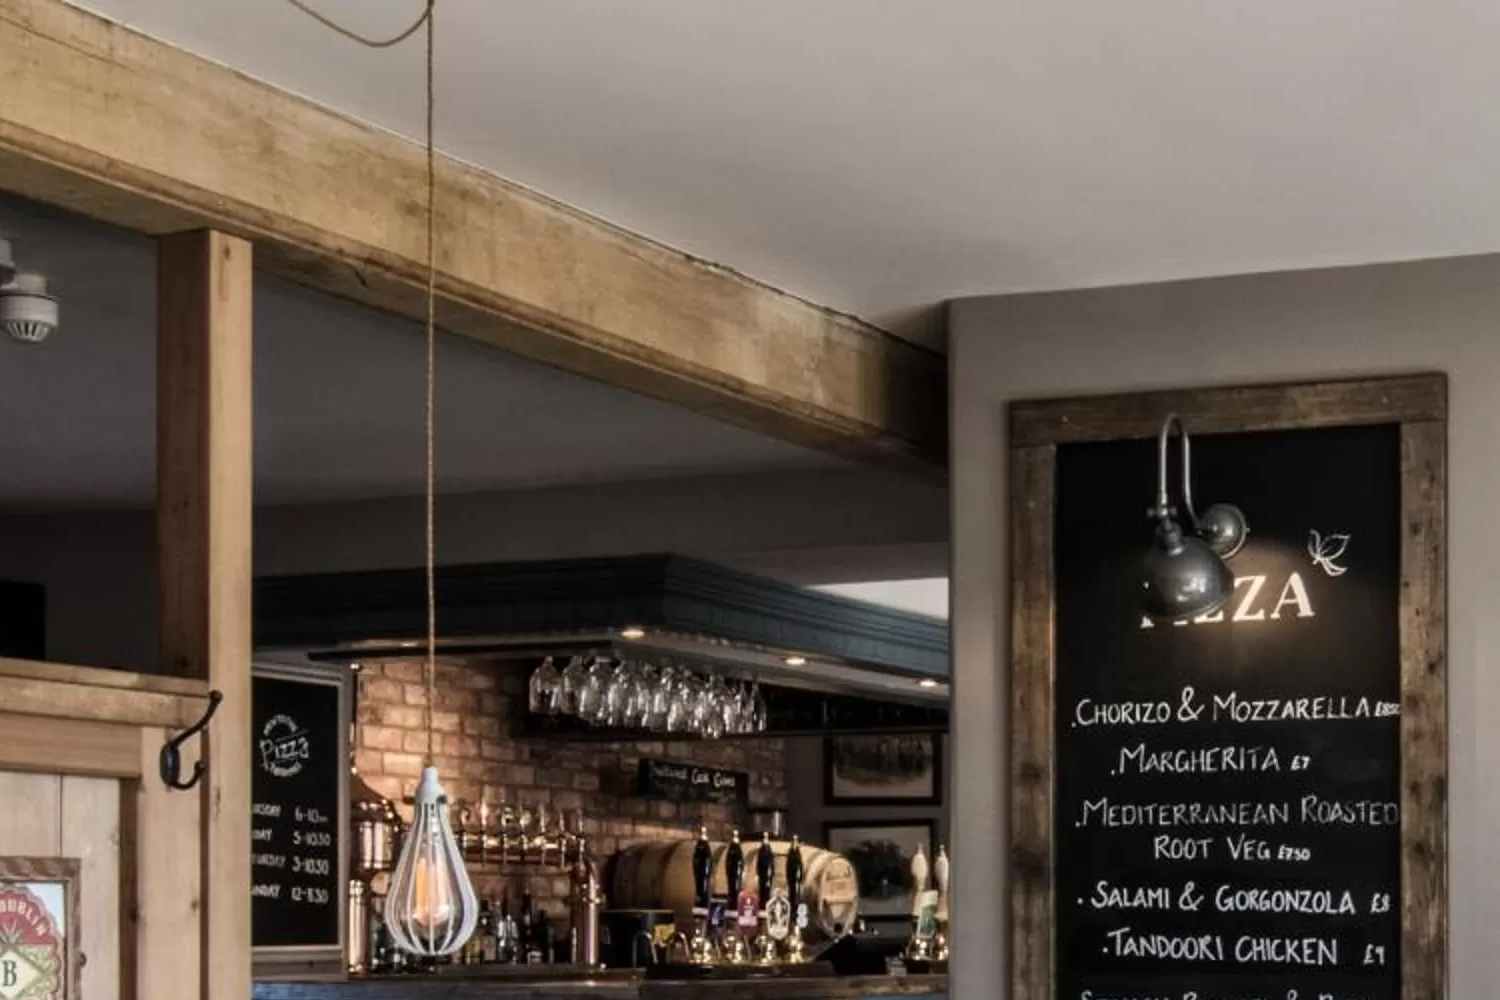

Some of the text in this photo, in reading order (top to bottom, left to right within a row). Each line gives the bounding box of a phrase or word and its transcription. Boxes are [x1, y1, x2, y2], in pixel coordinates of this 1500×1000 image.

[1075, 698, 1171, 725] CHORIZO
[1176, 685, 1205, 723] &
[1213, 691, 1370, 723] MOZZARELLA
[1119, 742, 1281, 774] MARGHERITA
[1082, 794, 1397, 827] MEDITERRANEAN ROASTED
[1153, 834, 1213, 860] ROOT
[1226, 832, 1272, 861] VEG
[1090, 879, 1170, 910] SALAMI
[1178, 881, 1205, 912] &
[1215, 884, 1356, 915] GORGONZOLA
[1107, 926, 1224, 961] TANDOORI
[1234, 935, 1338, 966] CHICKEN
[1, 960, 18, 987] B
